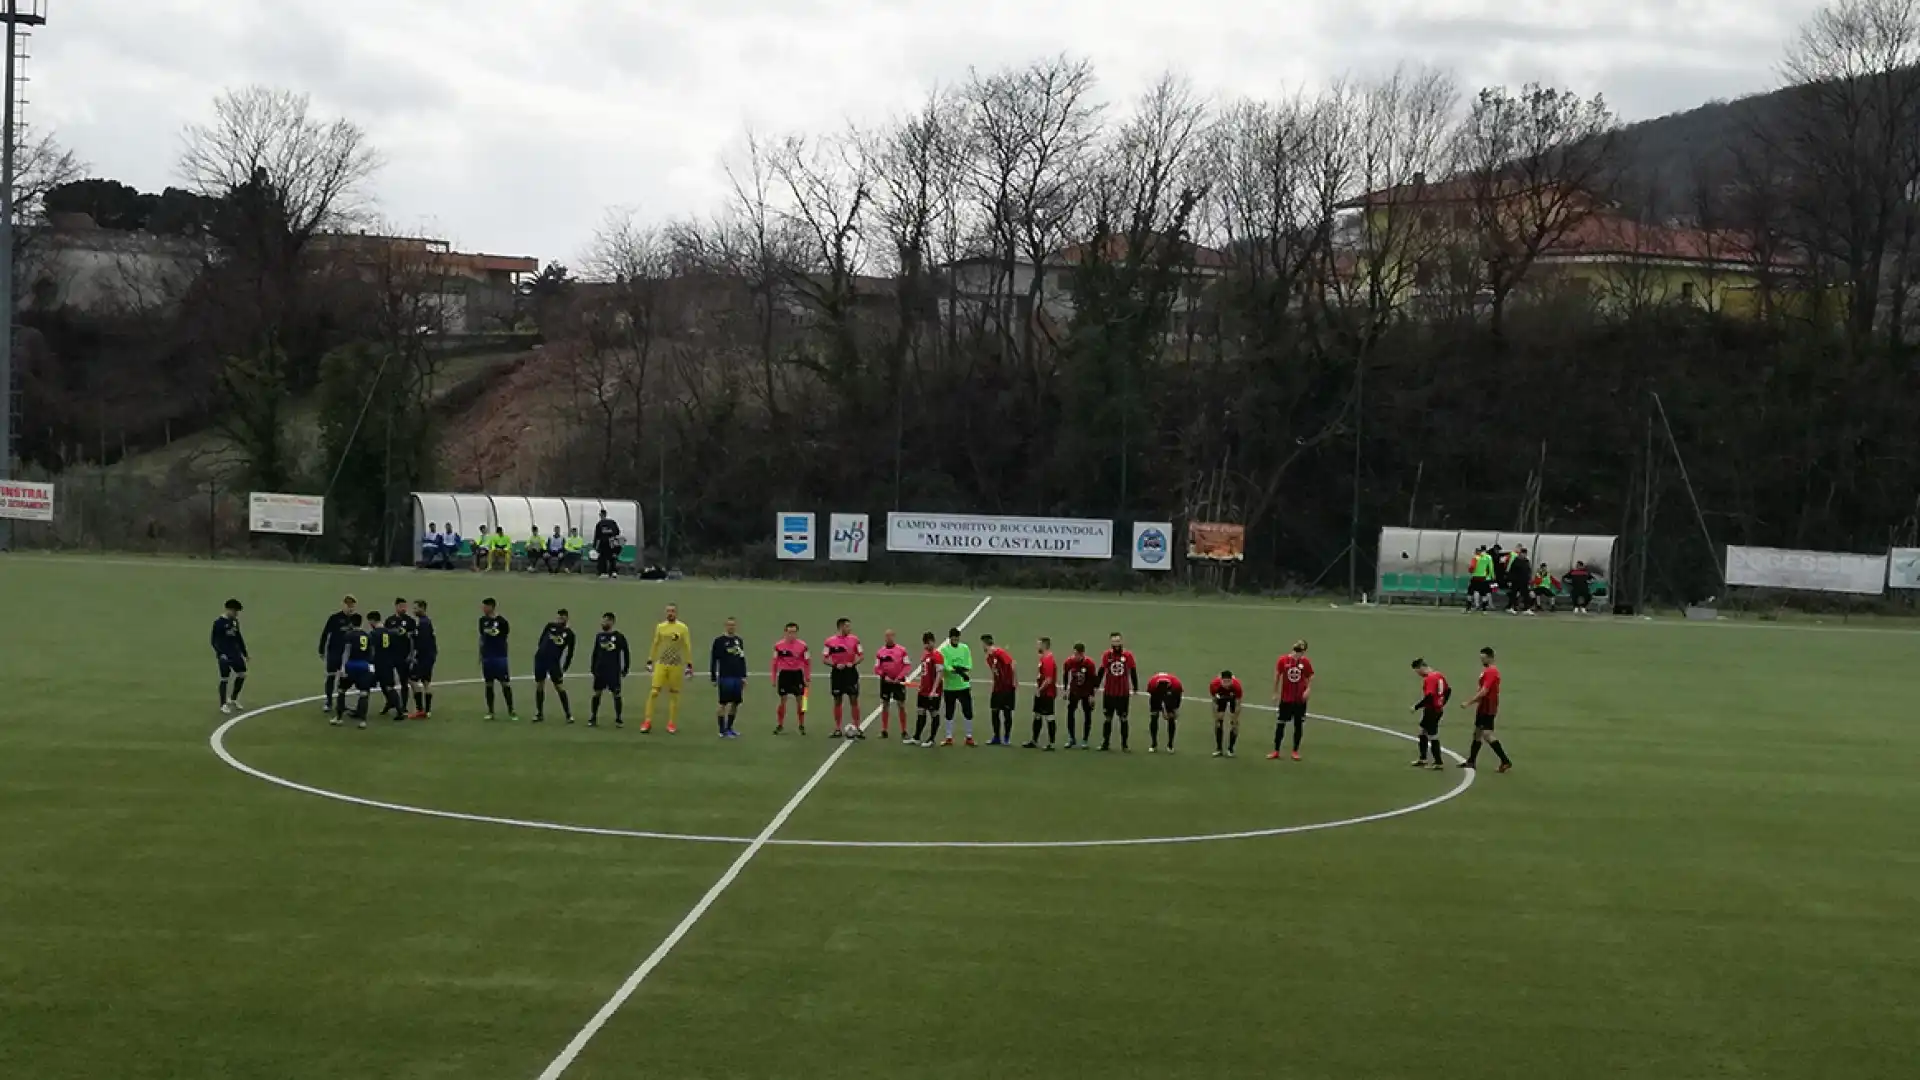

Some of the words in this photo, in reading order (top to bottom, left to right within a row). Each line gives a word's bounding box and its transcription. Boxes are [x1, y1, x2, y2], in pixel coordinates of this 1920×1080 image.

[897, 520, 937, 530] CAMPO
[940, 521, 997, 532] SPORTIVO
[1000, 523, 1104, 536] ROCCARAVINDOLA
[918, 533, 982, 548] "MARIO
[988, 535, 1081, 551] CASTALDI"
[360, 635, 368, 651] 9
